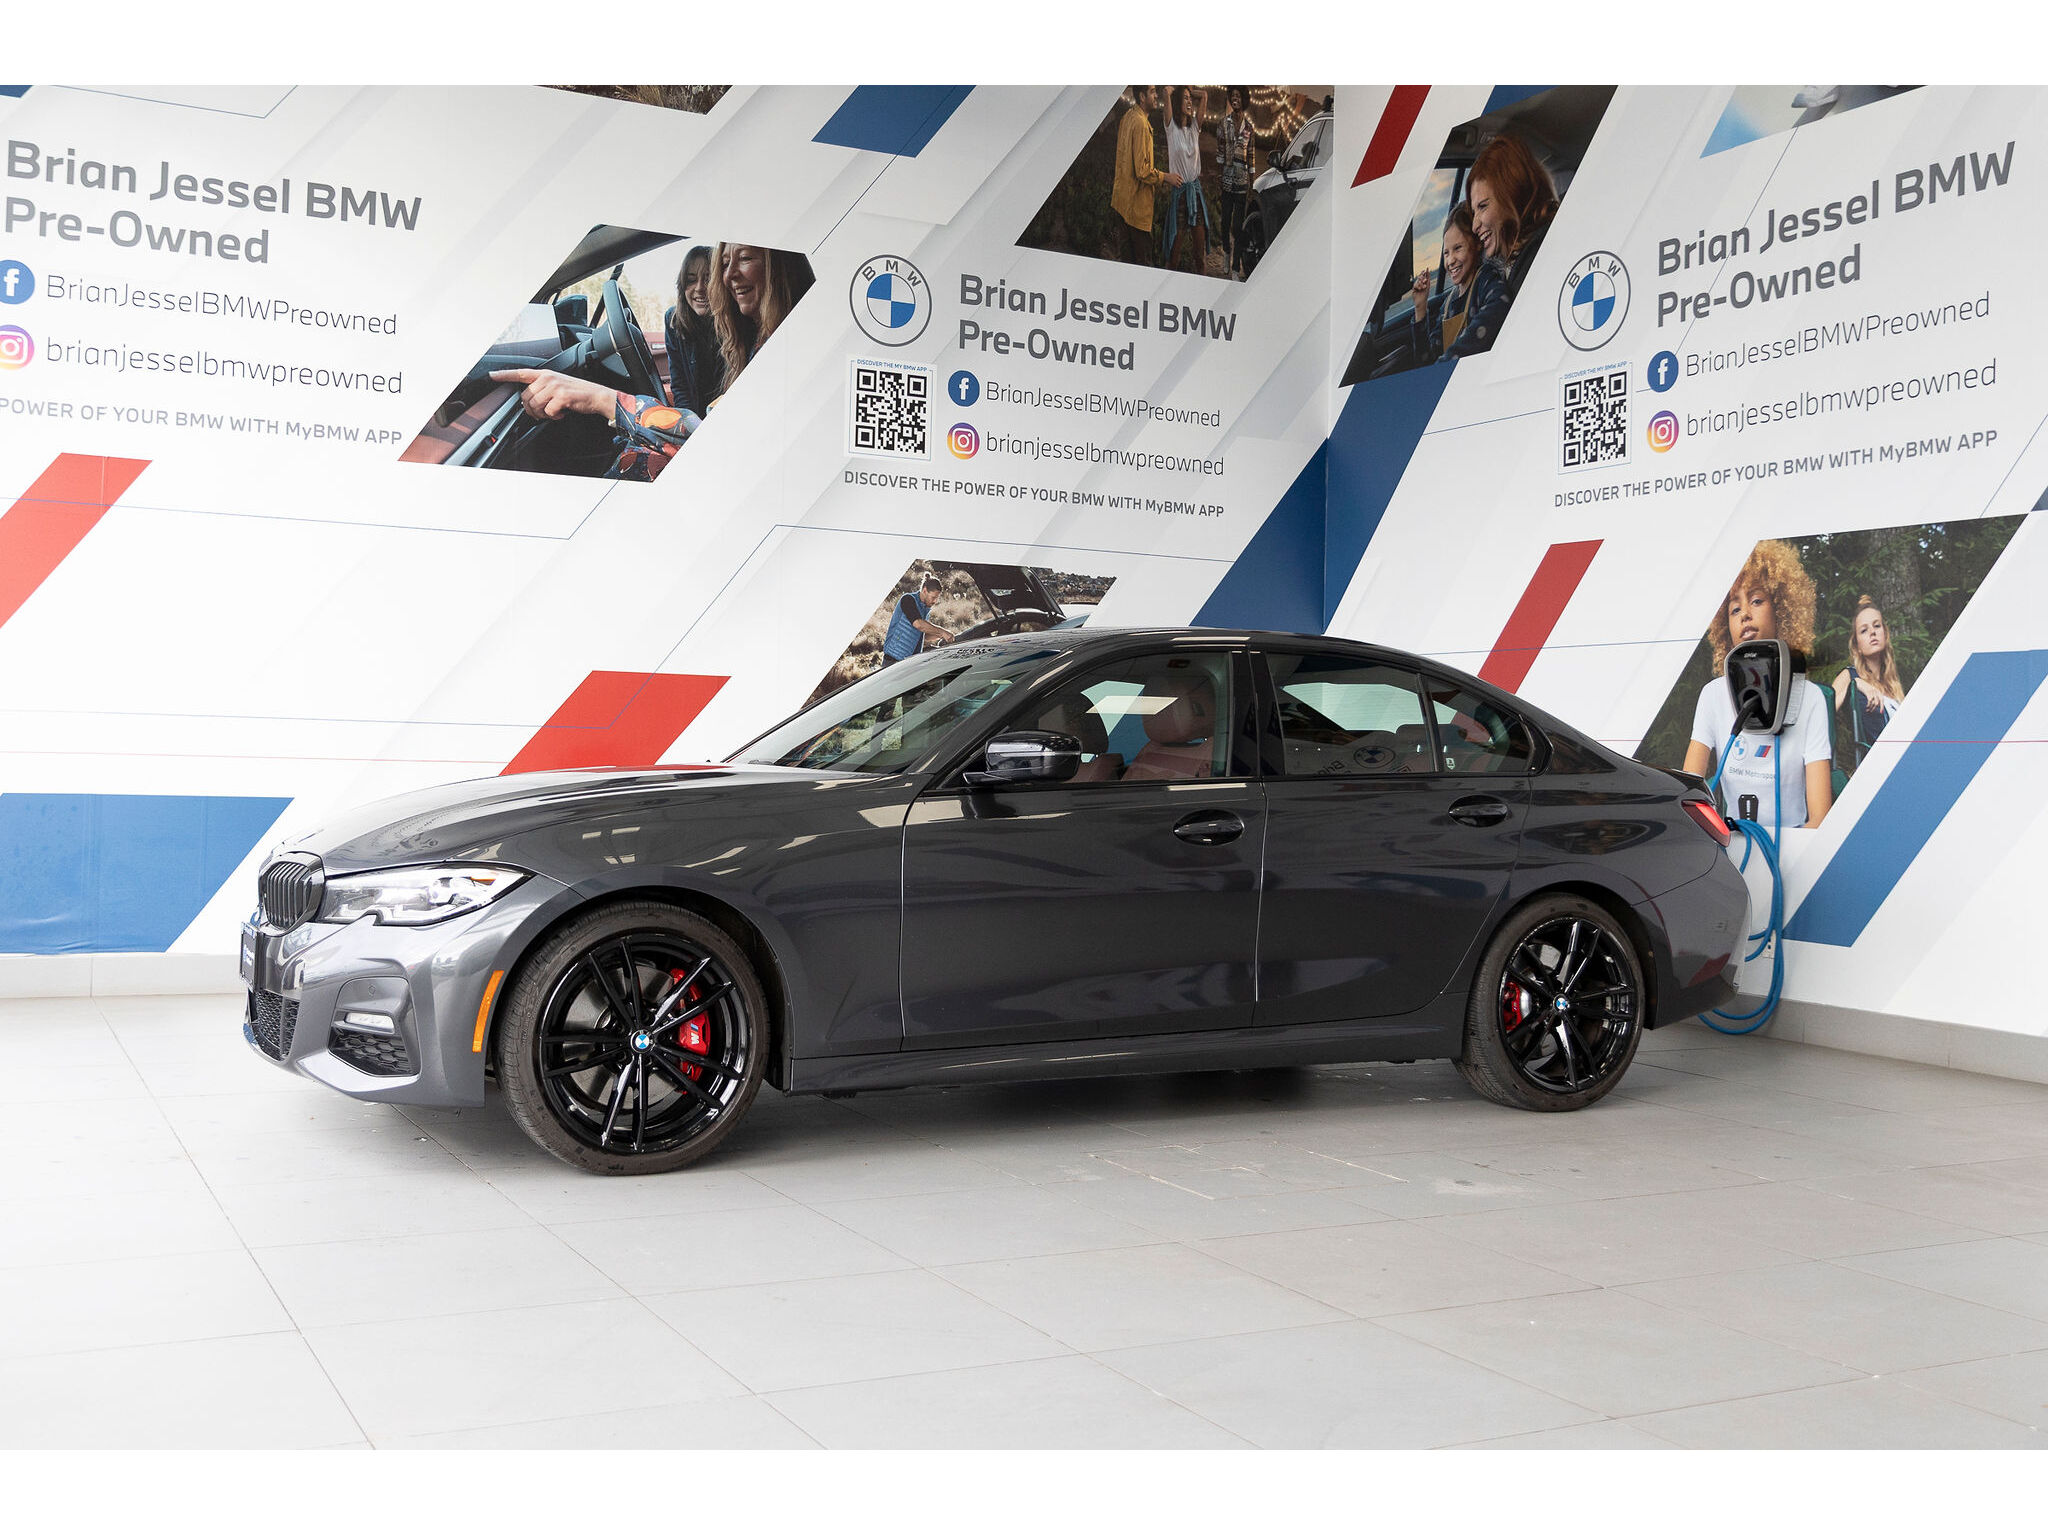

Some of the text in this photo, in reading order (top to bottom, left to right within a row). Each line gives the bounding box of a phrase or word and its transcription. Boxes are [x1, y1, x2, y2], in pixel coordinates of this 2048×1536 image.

[8, 140, 422, 231] Brian Jessel BMW
[1658, 141, 2015, 276] Brian Jessel BMW
[6, 197, 268, 264] Pre-Owned
[862, 260, 922, 287] BMW
[1568, 256, 1621, 289] BMW
[1658, 244, 1861, 328] Pre-Owned
[48, 275, 396, 335] BrianJesselBMWPreowned
[960, 274, 1236, 341] Brian Jessel BMW
[1687, 291, 1989, 376] BrianJesselBMWPreowned
[48, 337, 401, 393] brianjesselbmwpreowned
[857, 359, 883, 367] DISCOVER
[960, 320, 1134, 370] Pre-Owned
[81, 405, 107, 420] OF
[113, 407, 168, 425] YOUR
[176, 412, 223, 429] BMW
[230, 417, 278, 434] WITH
[286, 422, 359, 441] MyBMW
[365, 429, 402, 444] APP
[987, 382, 1220, 427] BrianJesselBMWPreowned
[1687, 359, 1997, 437] brianjesselbmwpreowned
[987, 432, 1223, 475] brianjesselbmwpreowned
[1555, 430, 1997, 507] DISCOVER THE POWER OF YOUR BMW WITH MyBMW APP
[845, 471, 1224, 517] DISCOVER THE POWER OF YOUR BMW WITH MyBMW APP
